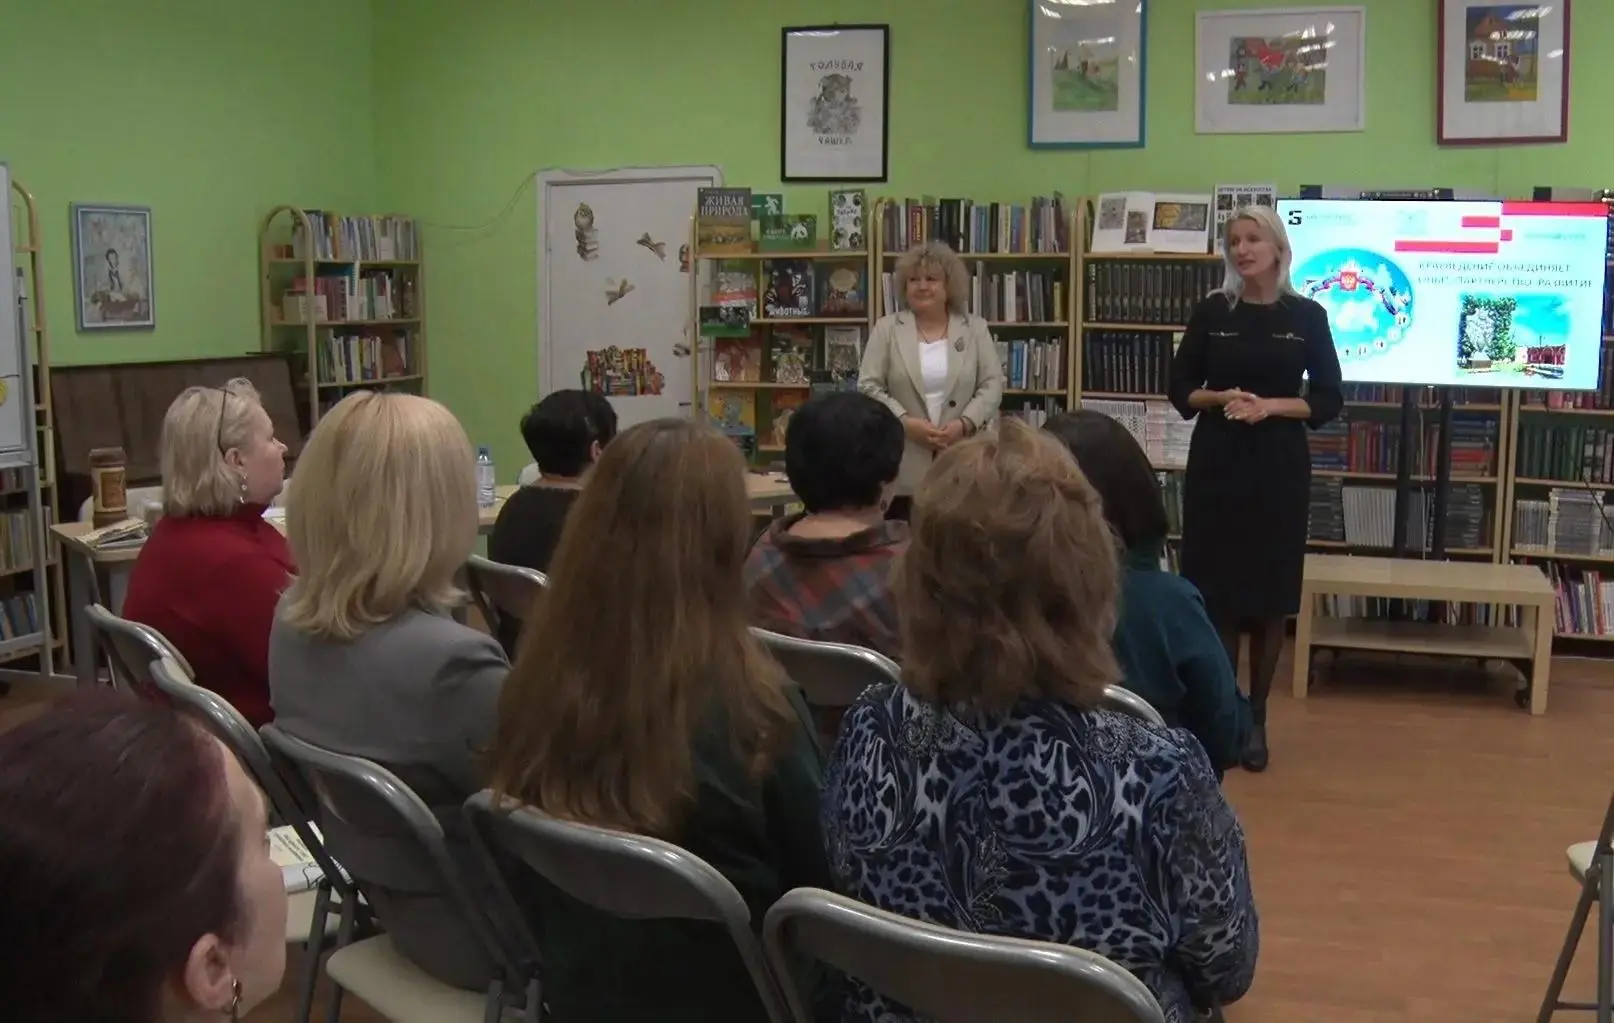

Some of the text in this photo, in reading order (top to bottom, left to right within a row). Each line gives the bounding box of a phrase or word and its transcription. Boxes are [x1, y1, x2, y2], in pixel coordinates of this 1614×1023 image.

[809, 60, 865, 72] ГОЛУБАЯ
[704, 195, 745, 206] ЖИВАЯ
[701, 205, 750, 216] ПРИРОДА
